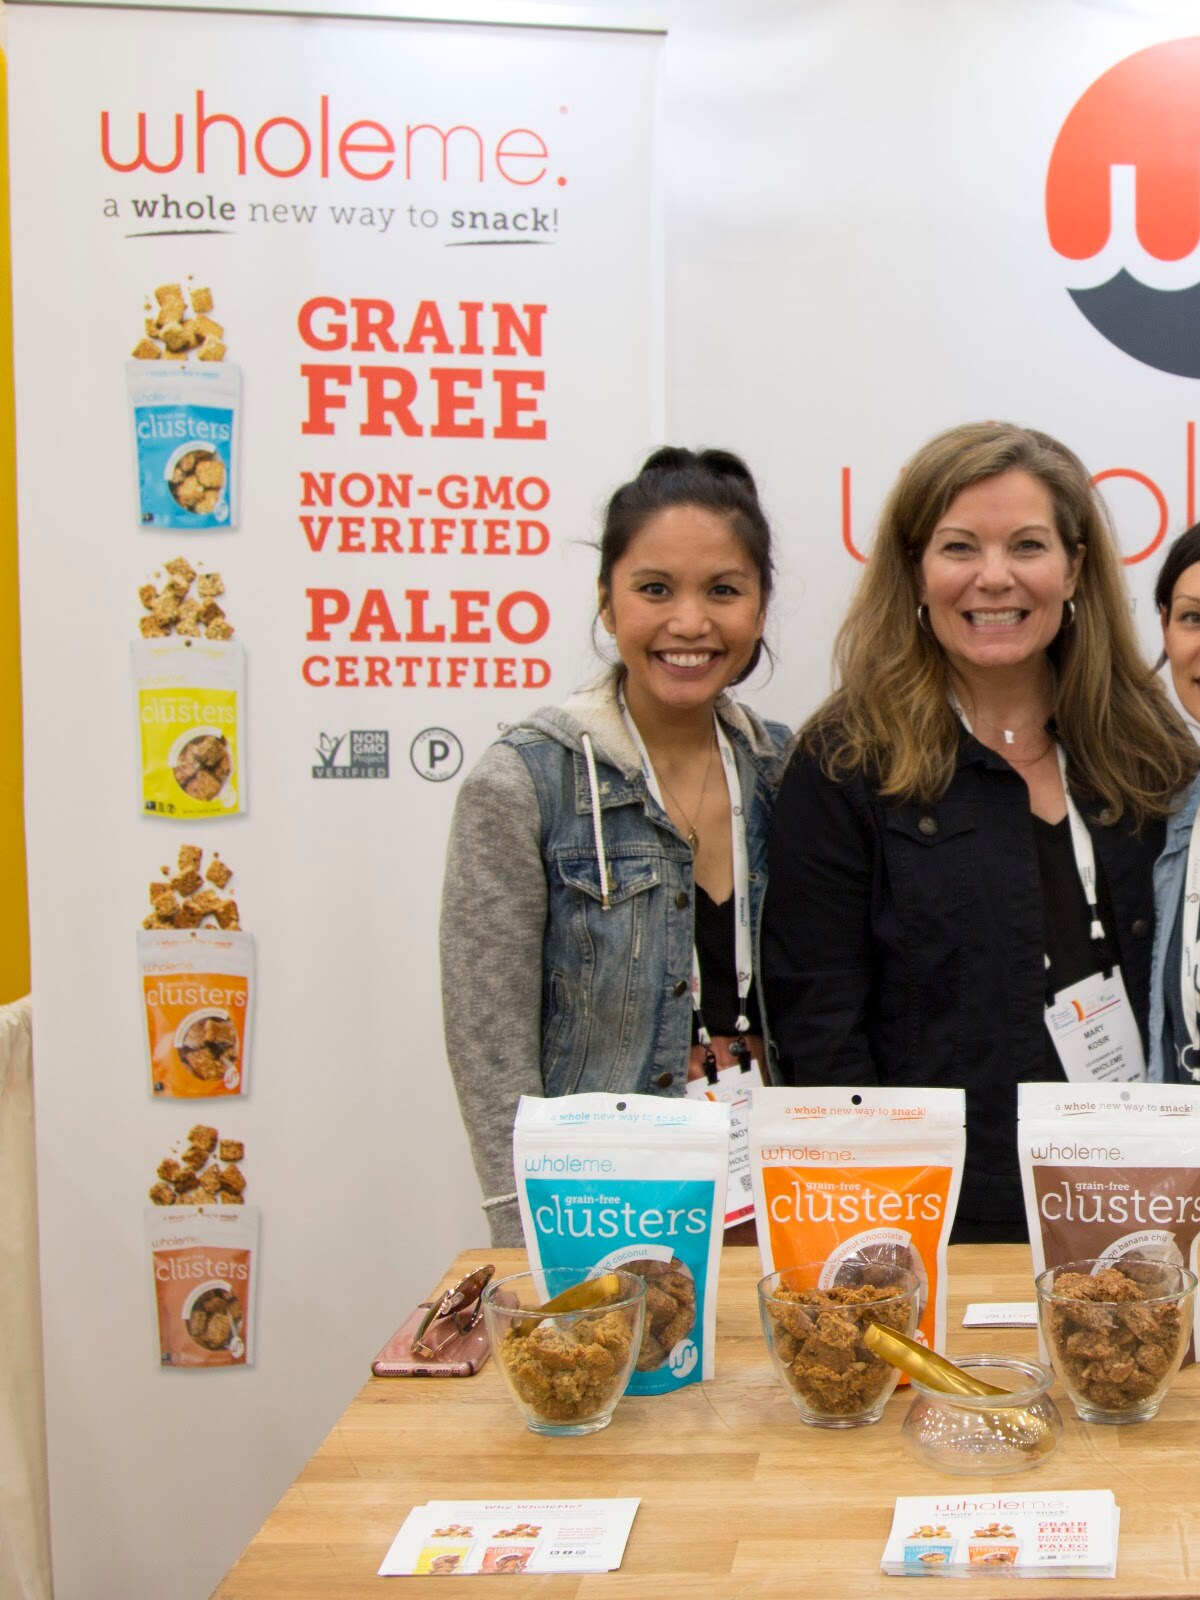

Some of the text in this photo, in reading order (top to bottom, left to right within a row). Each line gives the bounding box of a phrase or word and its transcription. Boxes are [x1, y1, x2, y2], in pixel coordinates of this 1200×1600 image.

[103, 194, 560, 234] a whole new way to snack!
[297, 296, 547, 358] GRAIN
[300, 363, 548, 441] FREE
[137, 413, 231, 441] clusters
[299, 471, 551, 512] NON-GMO
[299, 515, 551, 557] VERIFIED
[305, 587, 551, 646] PALEO
[302, 655, 552, 690] CERTIFIED
[352, 732, 386, 744] NON
[352, 744, 386, 755] GMO
[429, 739, 450, 769] P
[352, 755, 386, 765] Project
[315, 767, 387, 778] VERIFIED
[145, 982, 248, 1008] clusters
[1083, 1024, 1105, 1040] MARY
[1091, 1054, 1124, 1076] WHOLEME
[794, 1105, 827, 1115] whole
[854, 1107, 876, 1118] way
[878, 1107, 889, 1116] to
[891, 1106, 927, 1116] snack!
[1063, 1101, 1096, 1111] whole
[1124, 1103, 1144, 1113] way
[1147, 1104, 1157, 1112] to
[1160, 1104, 1194, 1113] snack!
[559, 1112, 591, 1121] whole
[592, 1113, 616, 1121] new
[617, 1114, 640, 1124] way
[761, 1146, 856, 1161] wholeme.
[1030, 1142, 1125, 1161] wholeme.
[524, 1154, 617, 1173] wholeme.
[805, 1181, 861, 1191] grain-free
[1075, 1181, 1130, 1192] grain-free
[564, 1193, 621, 1206] grain-free
[770, 1181, 942, 1223] clusters
[535, 1194, 708, 1238] clusters
[861, 1231, 904, 1244] chocolate
[1117, 1234, 1149, 1251] banana
[612, 1248, 648, 1265] coconut
[155, 1256, 248, 1282] clusters
